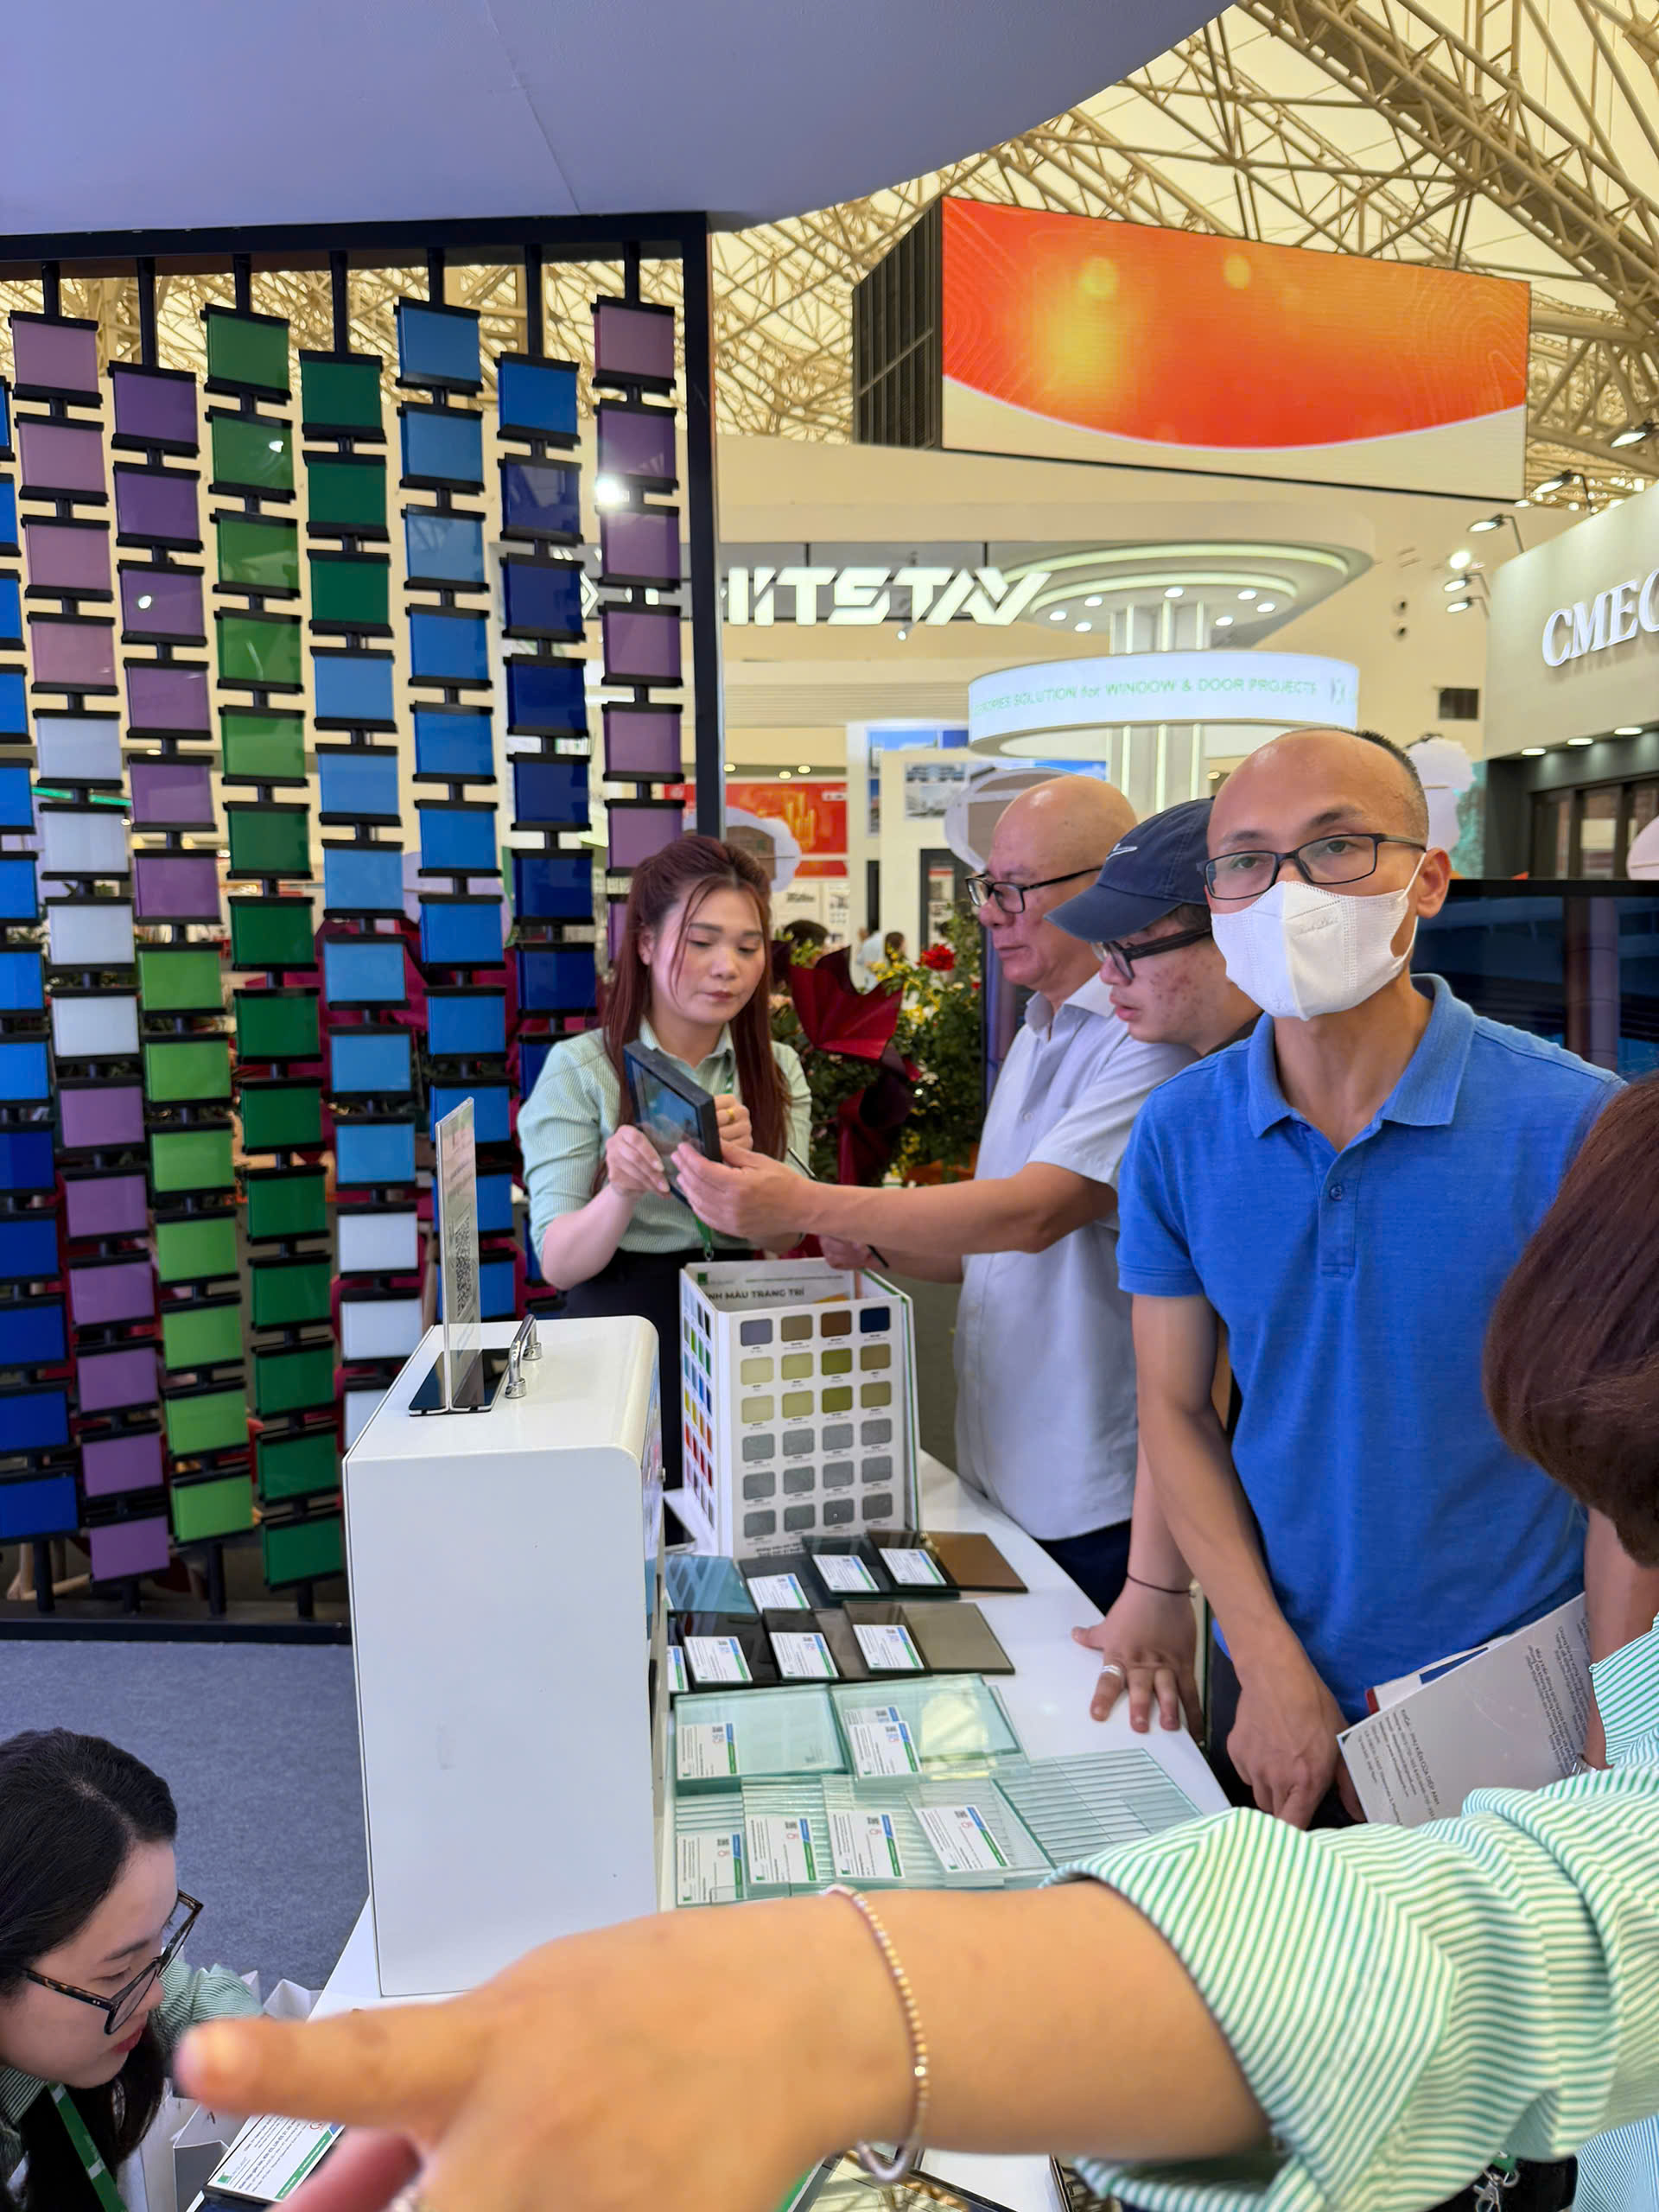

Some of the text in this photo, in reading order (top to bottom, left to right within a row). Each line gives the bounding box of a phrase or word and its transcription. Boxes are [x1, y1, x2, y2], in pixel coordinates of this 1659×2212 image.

[1014, 686, 1077, 706] SOLUTION
[1106, 678, 1175, 695] WINDOW
[1181, 679, 1192, 691] &
[1198, 677, 1244, 691] DOOR
[1249, 678, 1317, 696] PROJECTS
